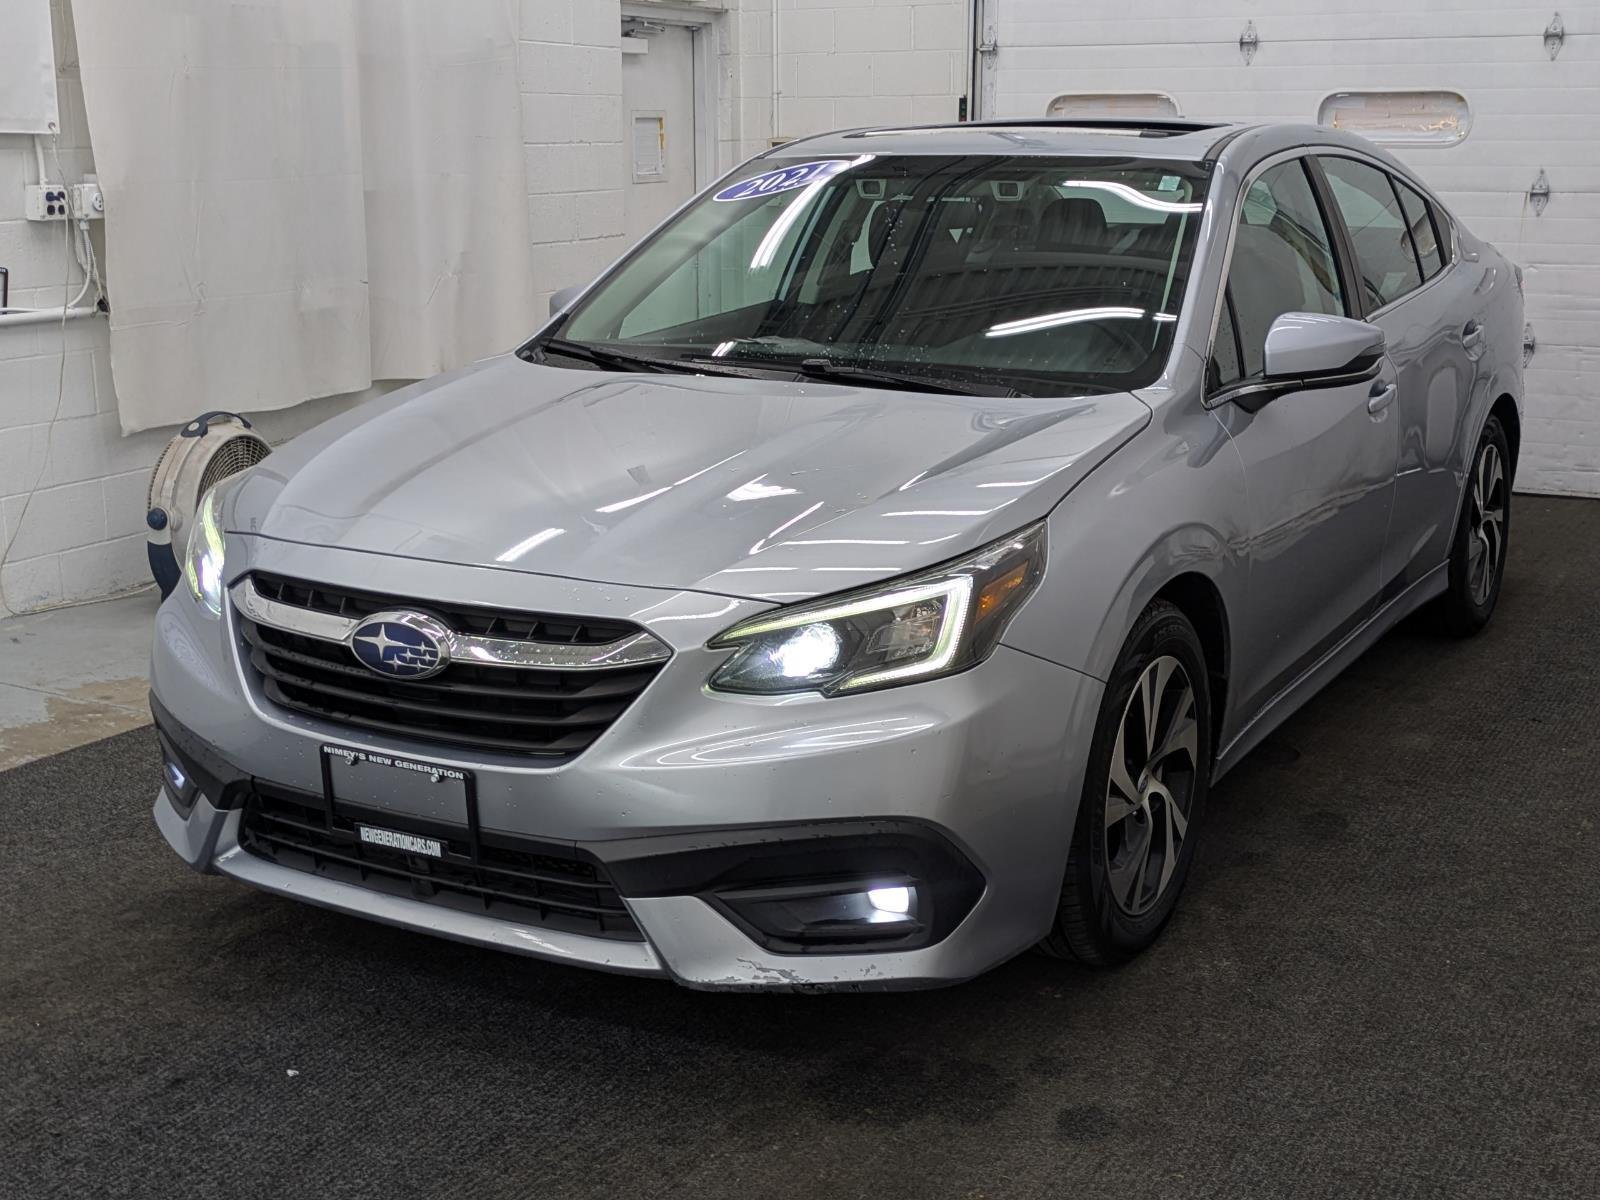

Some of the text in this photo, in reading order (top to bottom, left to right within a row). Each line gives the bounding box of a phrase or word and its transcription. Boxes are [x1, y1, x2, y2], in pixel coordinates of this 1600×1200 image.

[733, 162, 829, 198] 2021
[368, 754, 392, 765] NEW
[394, 760, 464, 780] GENERATION
[360, 826, 442, 858] NEWGENERATIONCARS.COM
